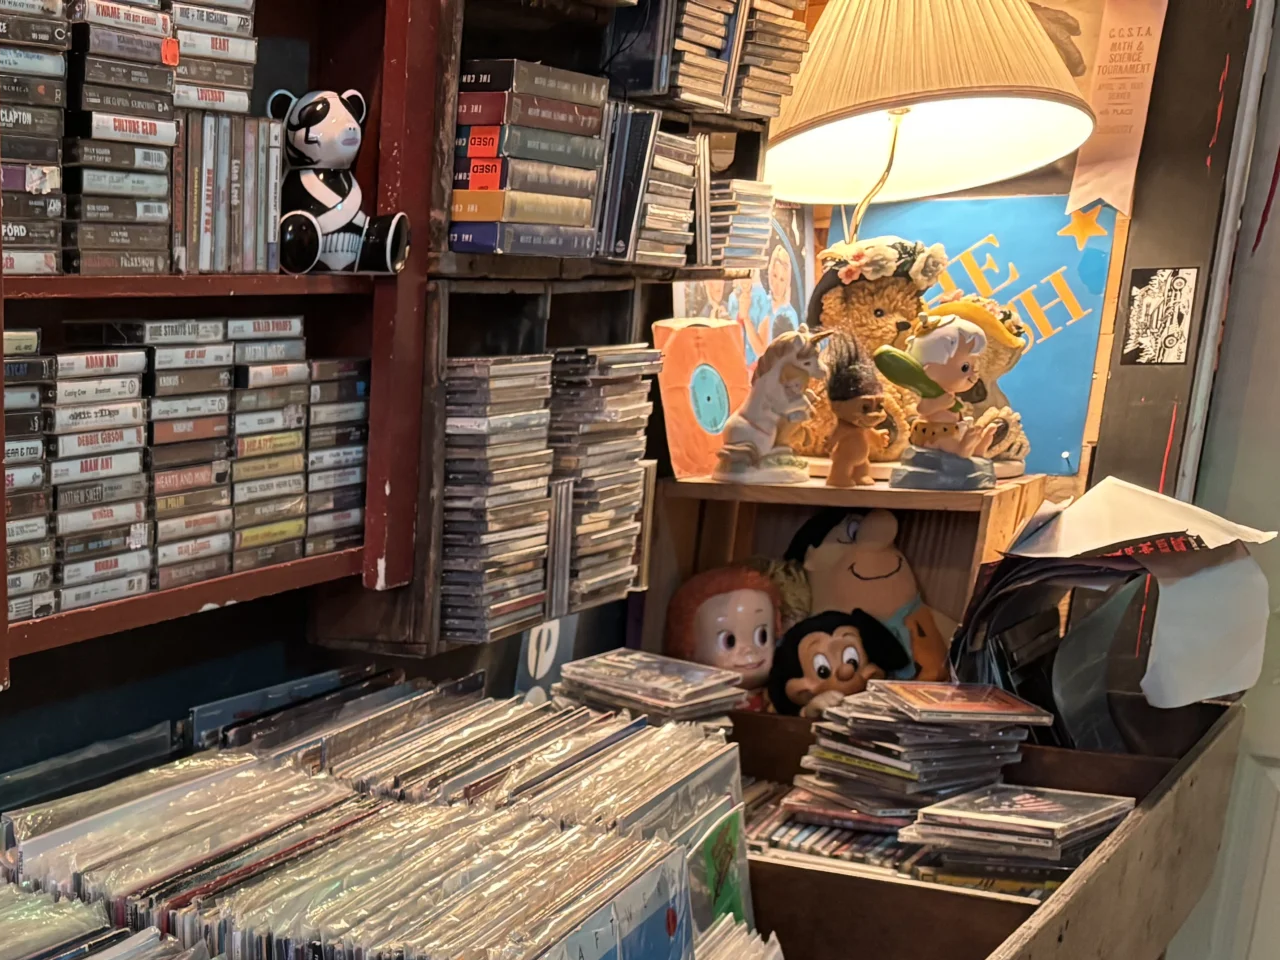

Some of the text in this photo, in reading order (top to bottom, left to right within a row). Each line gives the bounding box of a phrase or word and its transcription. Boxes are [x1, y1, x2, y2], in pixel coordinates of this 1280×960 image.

[1109, 52, 1142, 63] SCIENCE
[1097, 63, 1151, 75] TOURNAMENT
[0, 109, 32, 125] CLAPTON
[470, 137, 494, 146] USED
[472, 164, 497, 173] USED
[77, 430, 124, 447] DEBBIE GIBSON
